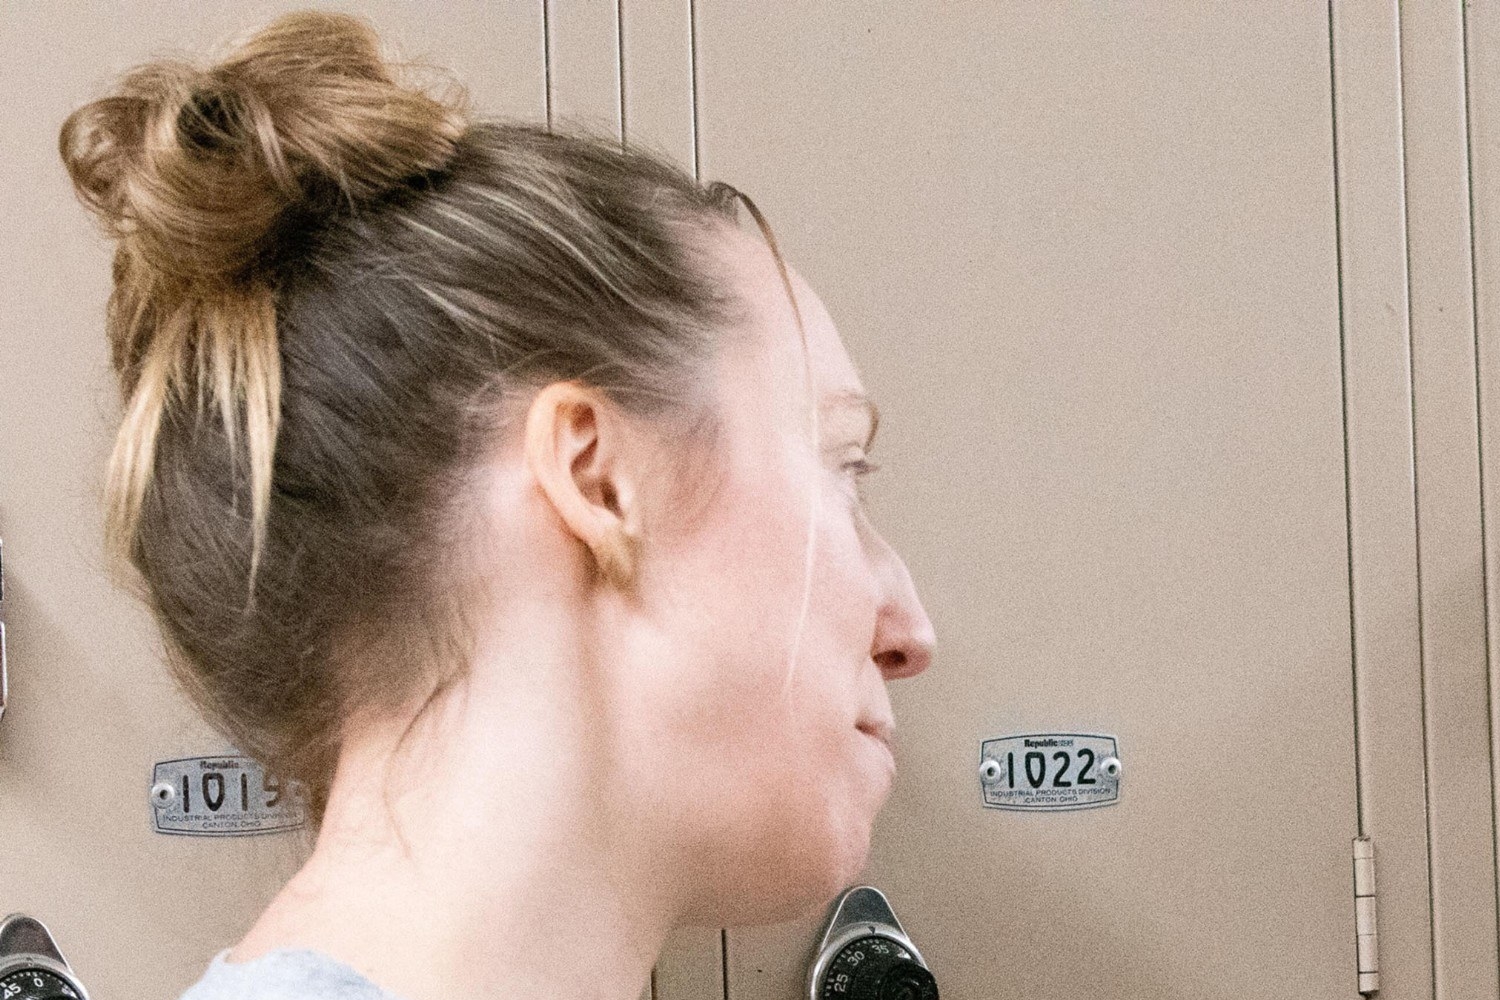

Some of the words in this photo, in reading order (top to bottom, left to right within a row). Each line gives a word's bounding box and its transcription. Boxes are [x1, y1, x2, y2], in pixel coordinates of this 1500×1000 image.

[1007, 748, 1096, 789] 1022
[847, 950, 865, 967] 30
[33, 977, 44, 988] 0
[833, 973, 849, 993] 25
[4, 983, 21, 1000] 45
